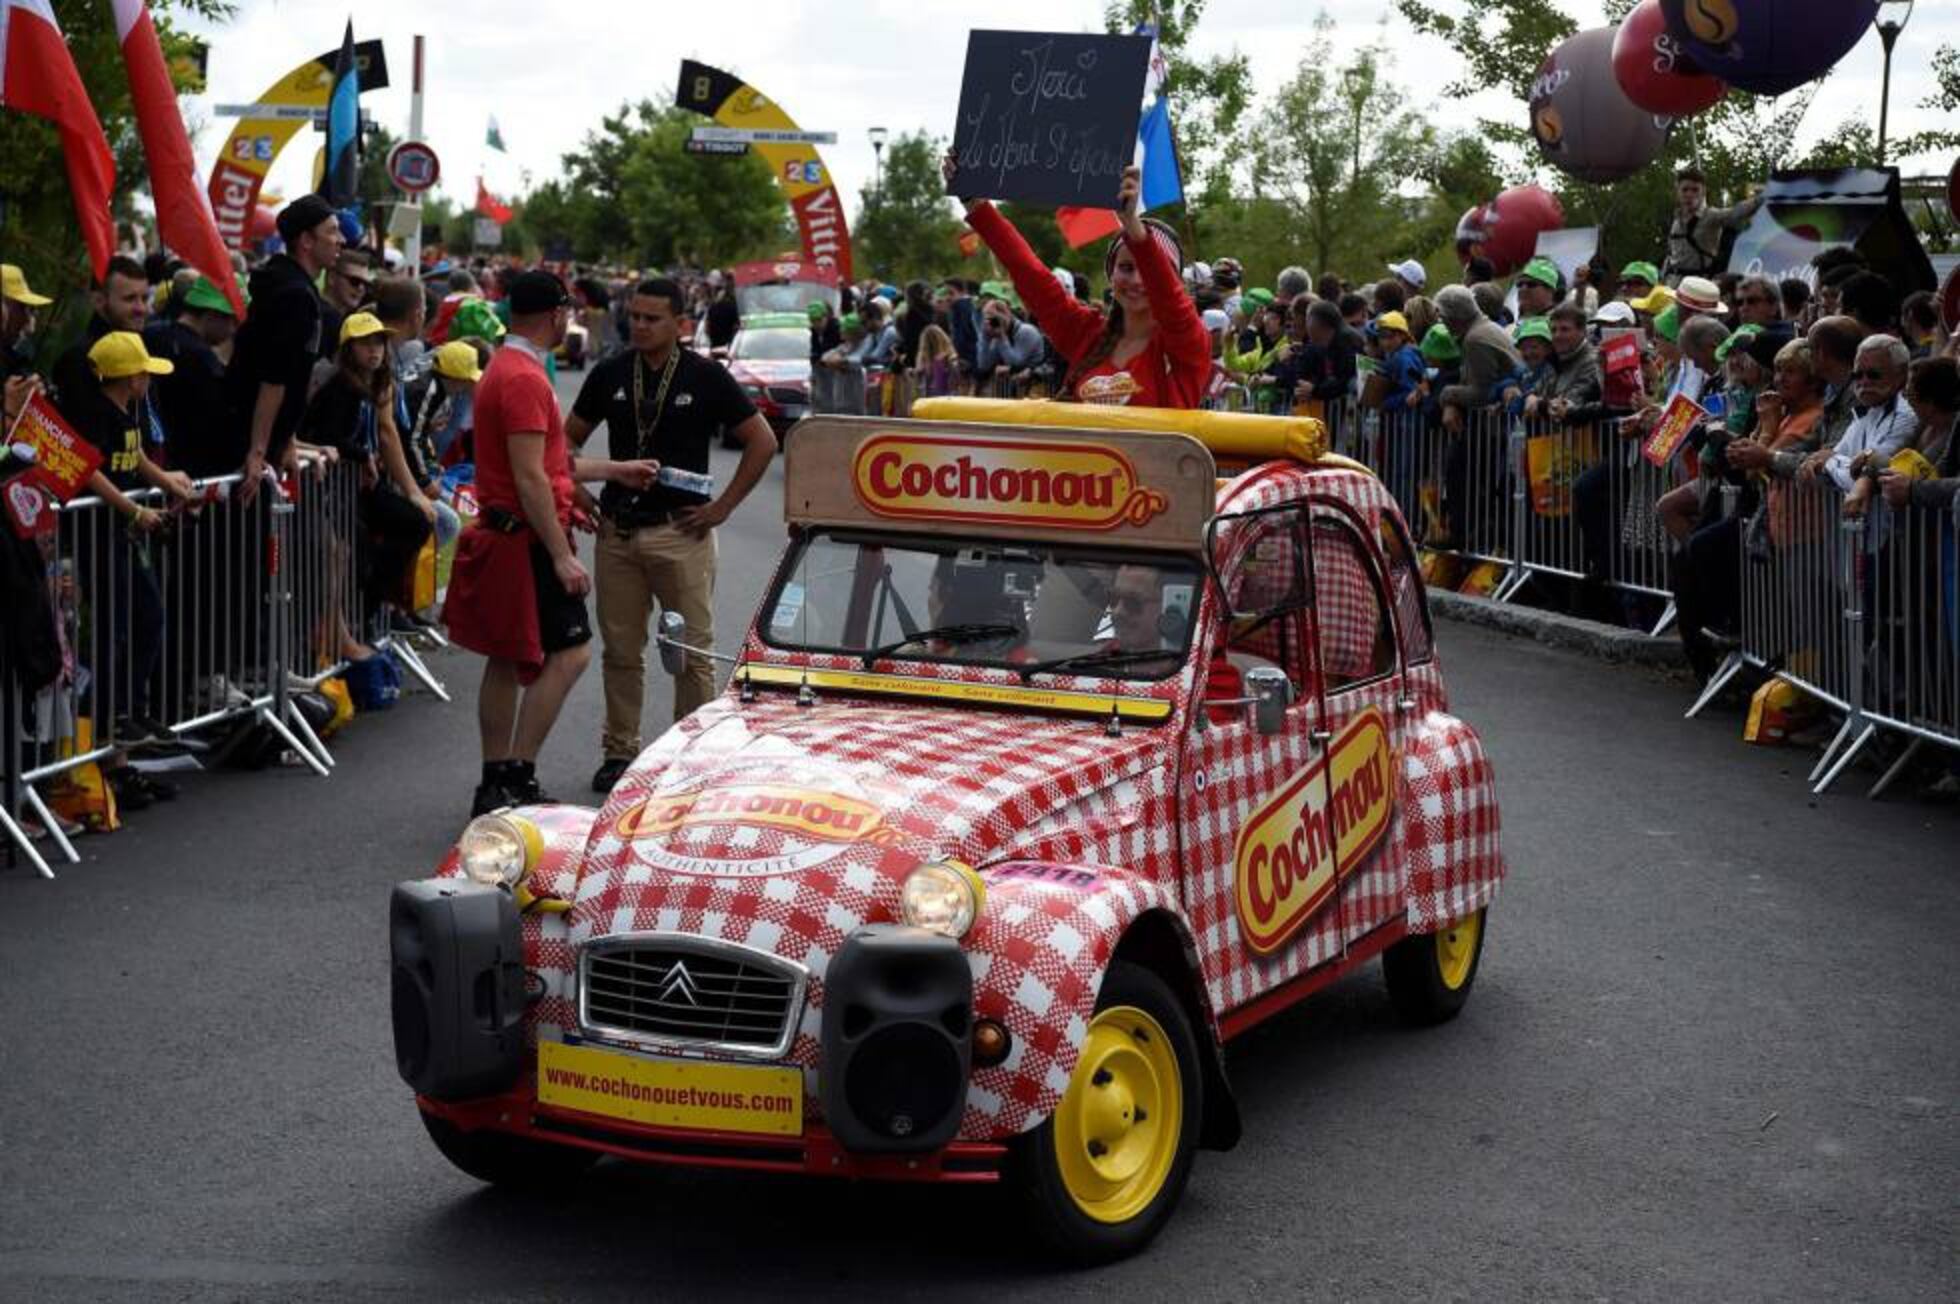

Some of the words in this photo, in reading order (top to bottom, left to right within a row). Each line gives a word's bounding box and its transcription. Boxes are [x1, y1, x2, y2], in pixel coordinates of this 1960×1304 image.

[1012, 39, 1087, 113] Merci
[805, 190, 840, 271] Vitte
[869, 451, 1114, 508] Cochonou
[545, 1065, 794, 1114] www.cochonouetvous.com
